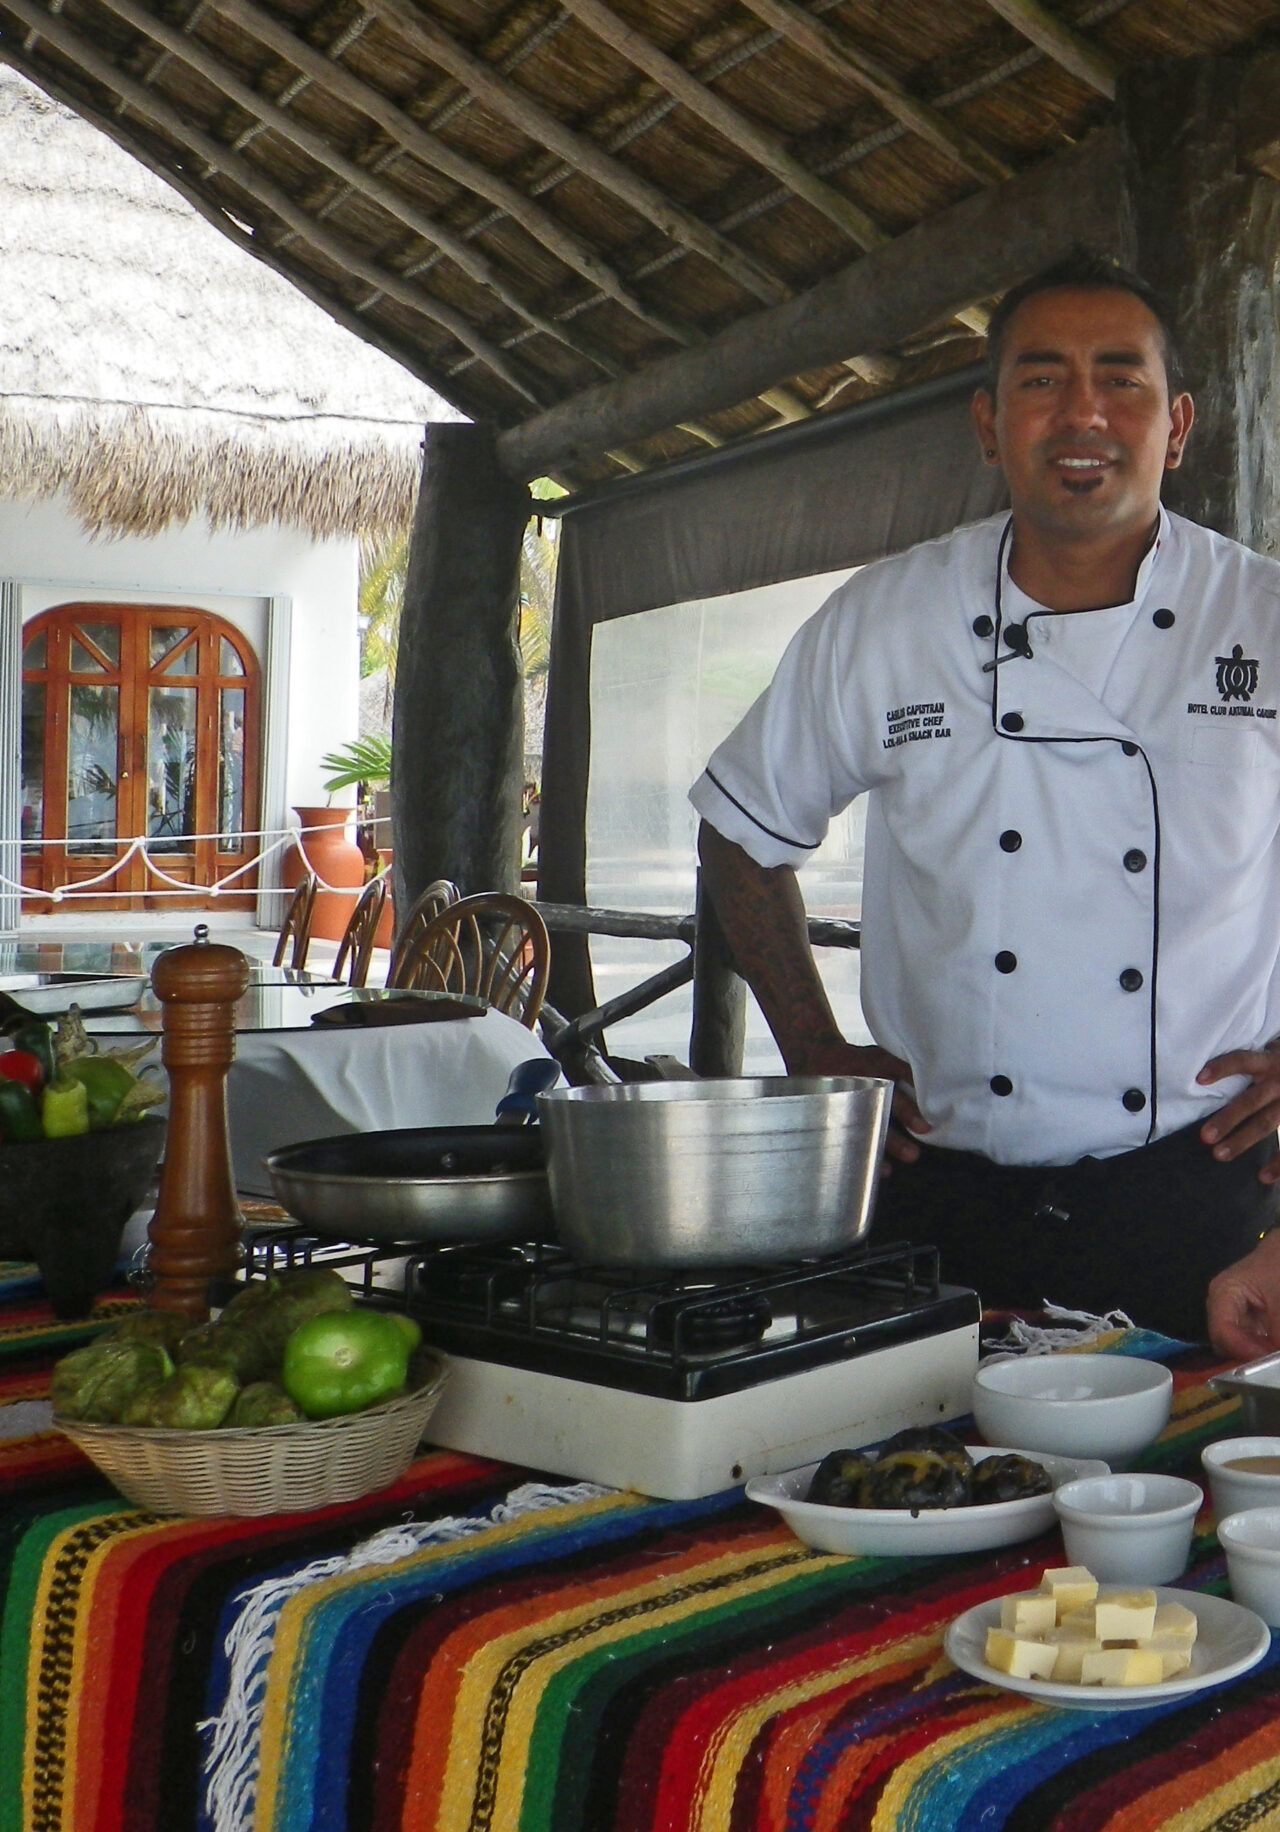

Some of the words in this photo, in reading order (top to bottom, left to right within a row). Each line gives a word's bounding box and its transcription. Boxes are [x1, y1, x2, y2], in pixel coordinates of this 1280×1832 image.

[1187, 703, 1208, 714] HOTEL
[1210, 705, 1227, 716] CLUB
[923, 716, 944, 727] CHEF
[908, 729, 933, 741] SNACK
[935, 728, 951, 738] BAR
